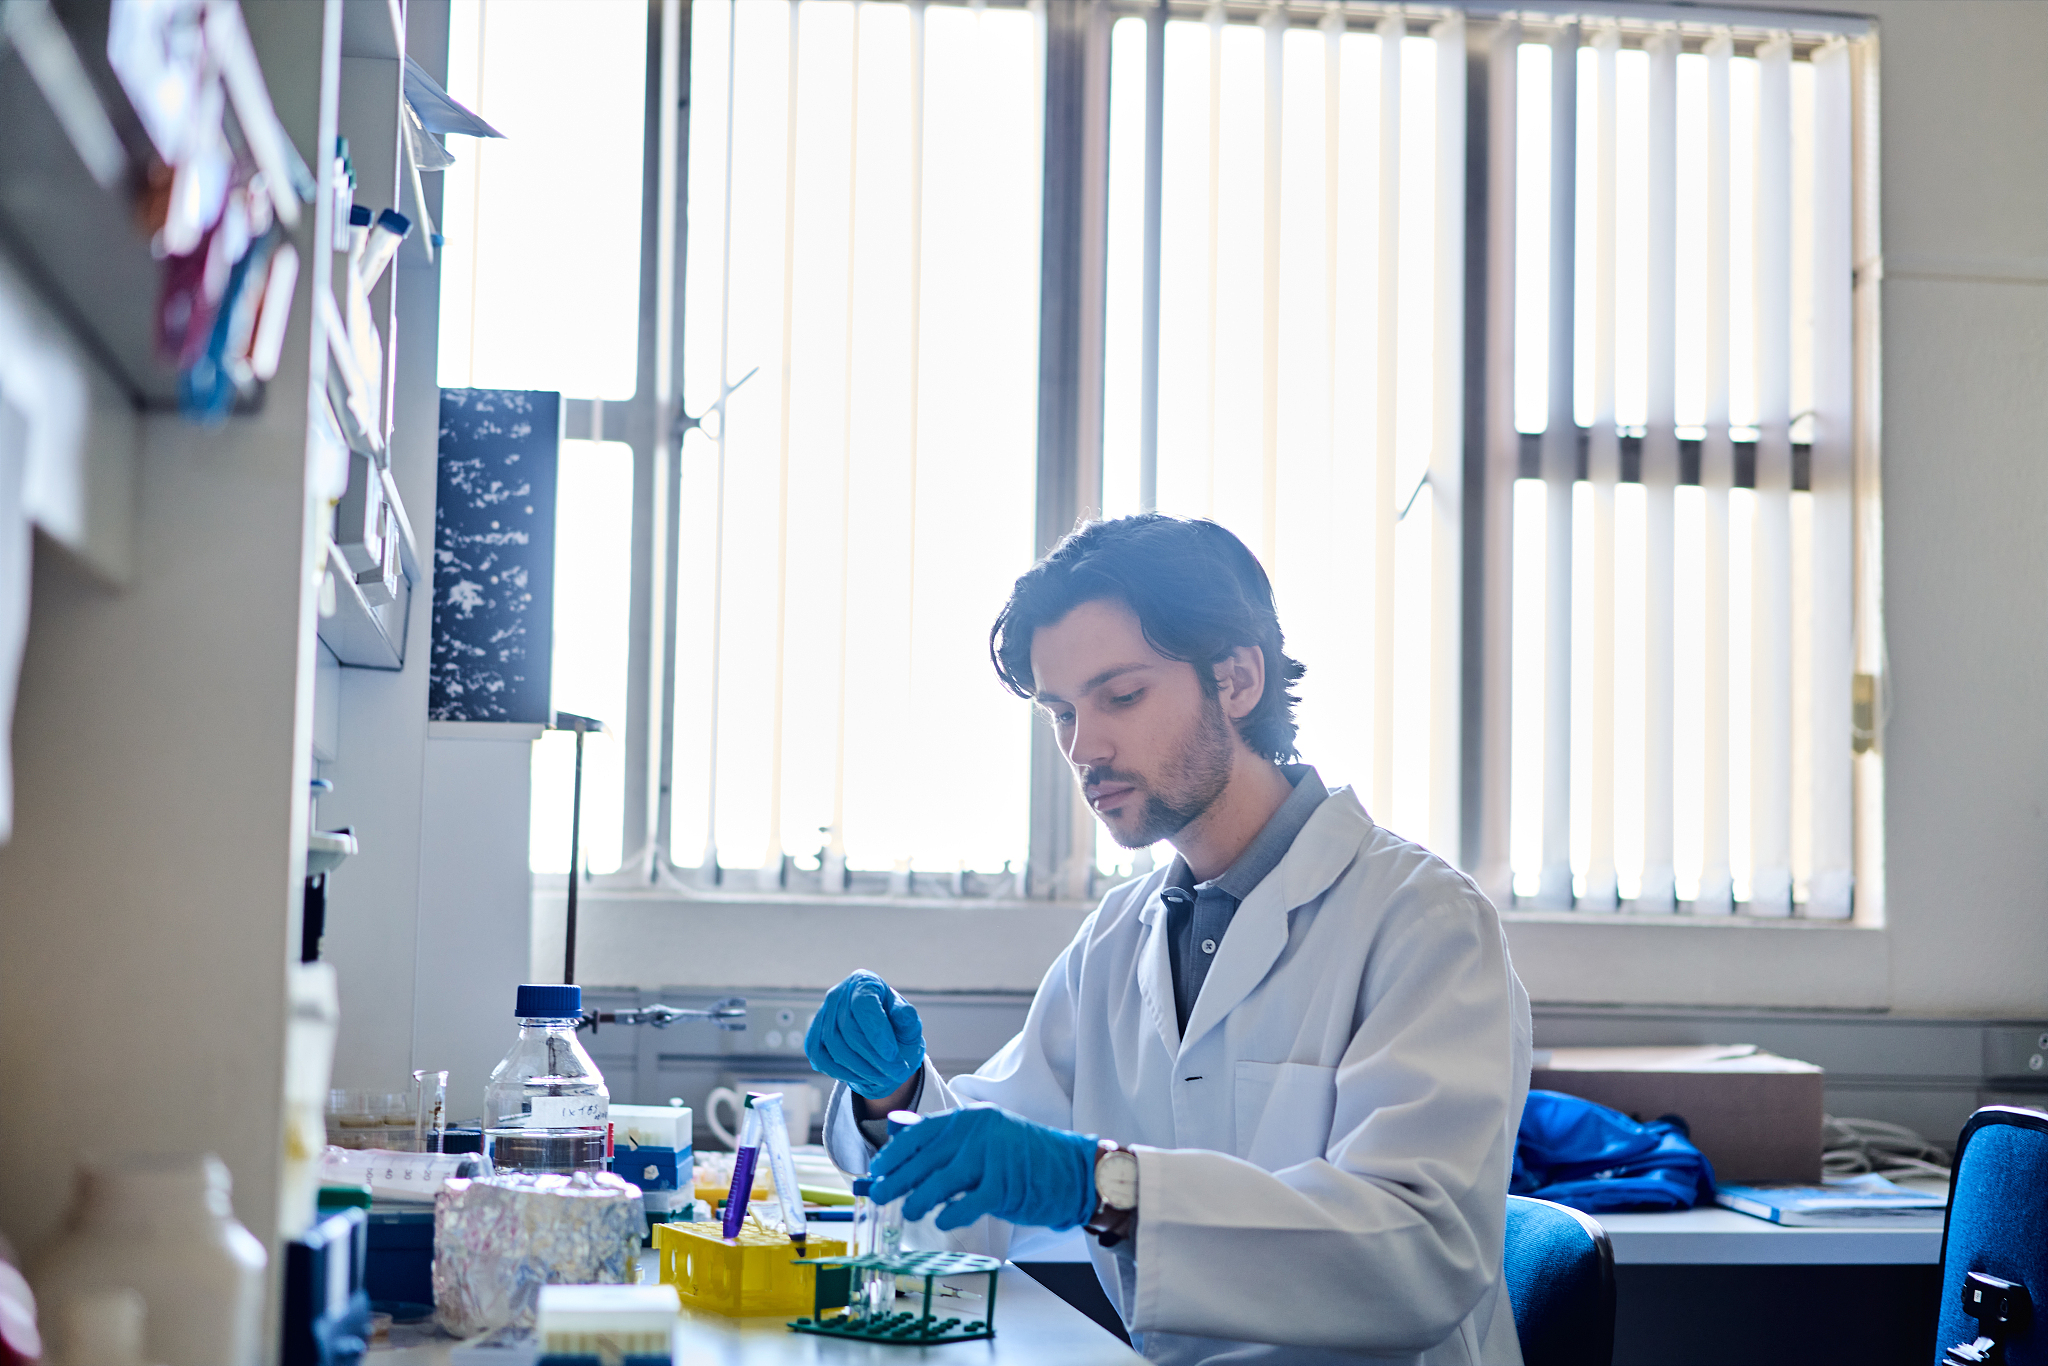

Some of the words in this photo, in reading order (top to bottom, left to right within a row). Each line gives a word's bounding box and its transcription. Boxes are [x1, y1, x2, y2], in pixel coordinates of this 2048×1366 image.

[385, 1168, 393, 1180] 40
[404, 1169, 412, 1180] 30
[423, 1170, 431, 1181] 20
